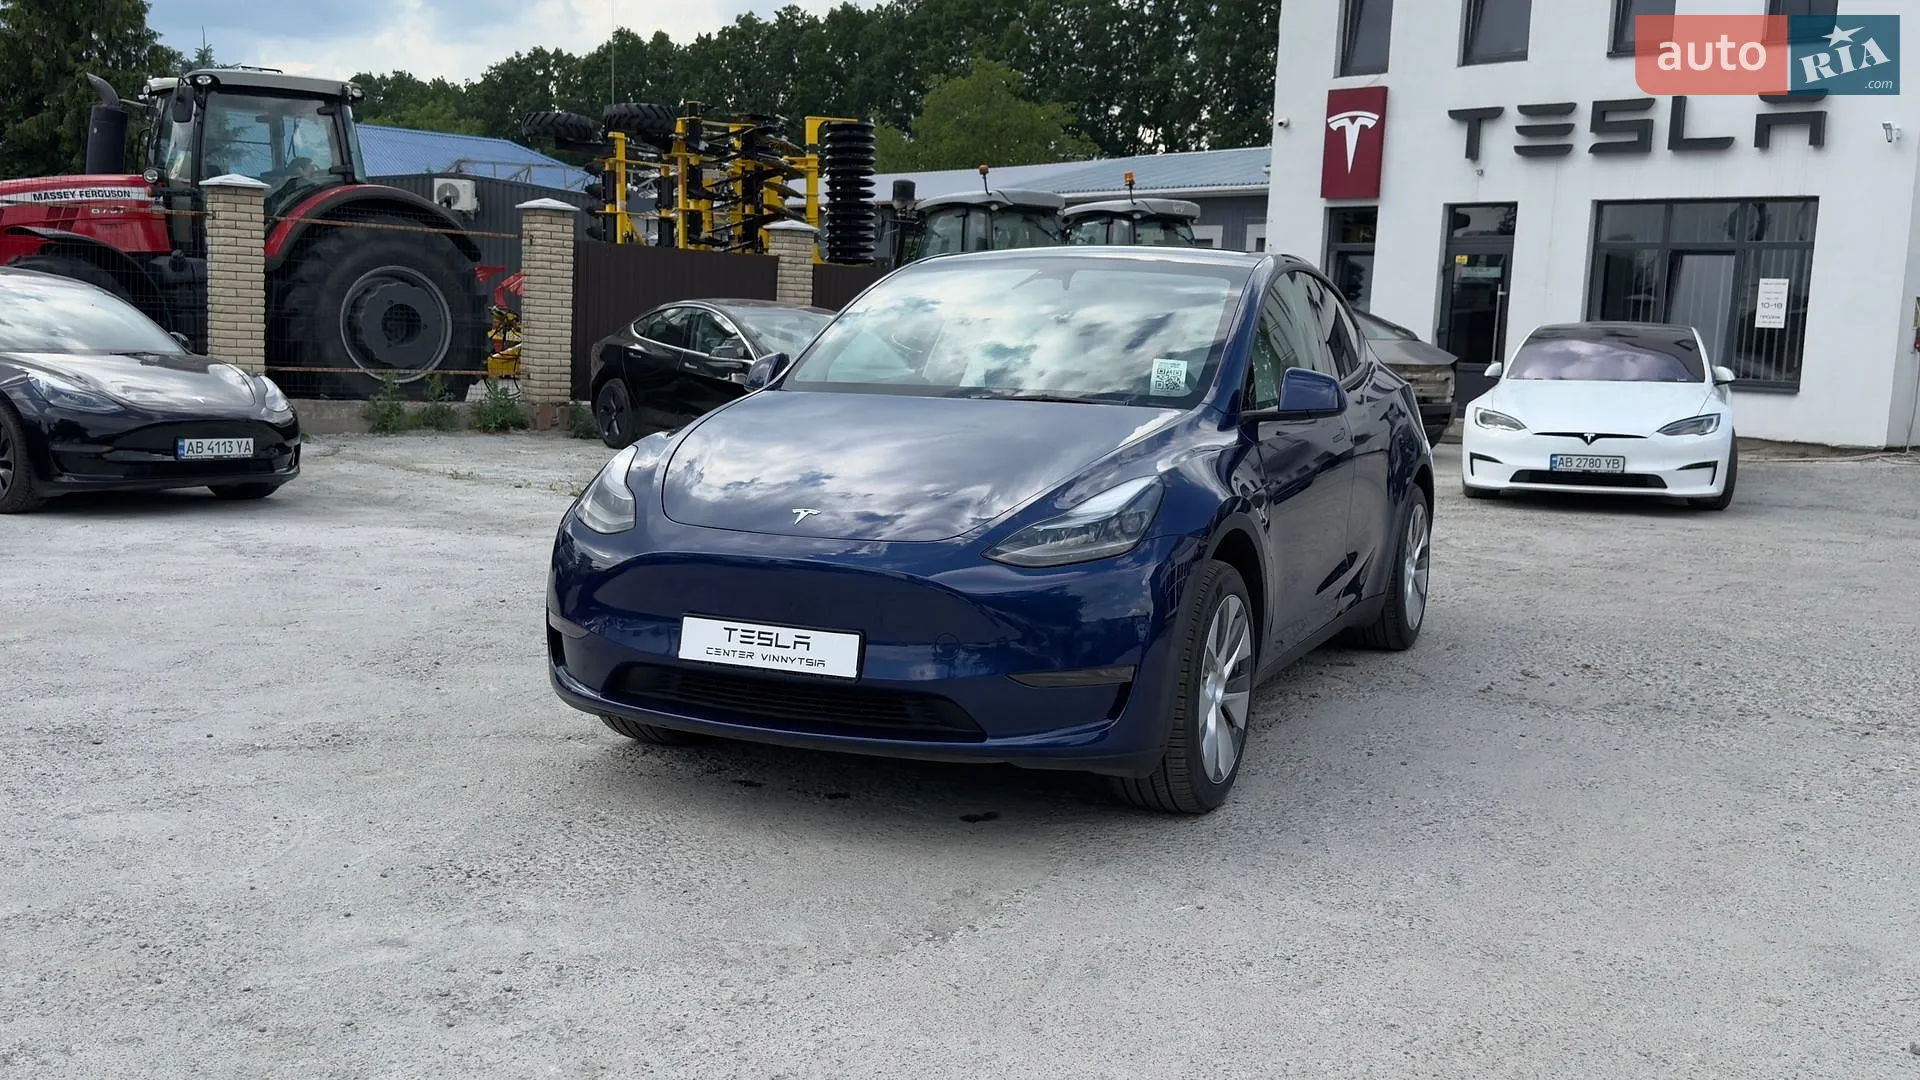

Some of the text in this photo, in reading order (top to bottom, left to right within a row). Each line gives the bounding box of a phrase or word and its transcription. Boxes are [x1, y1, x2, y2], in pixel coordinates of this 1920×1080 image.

[1447, 90, 1828, 160] TESLA
[33, 190, 131, 201] MASSEY FERGUSON
[186, 440, 252, 454] AB 4113 YA
[1558, 457, 1620, 469] AB 2780 YB
[724, 627, 811, 651] TESLA
[706, 647, 826, 667] CENTER VINNYTSIA
